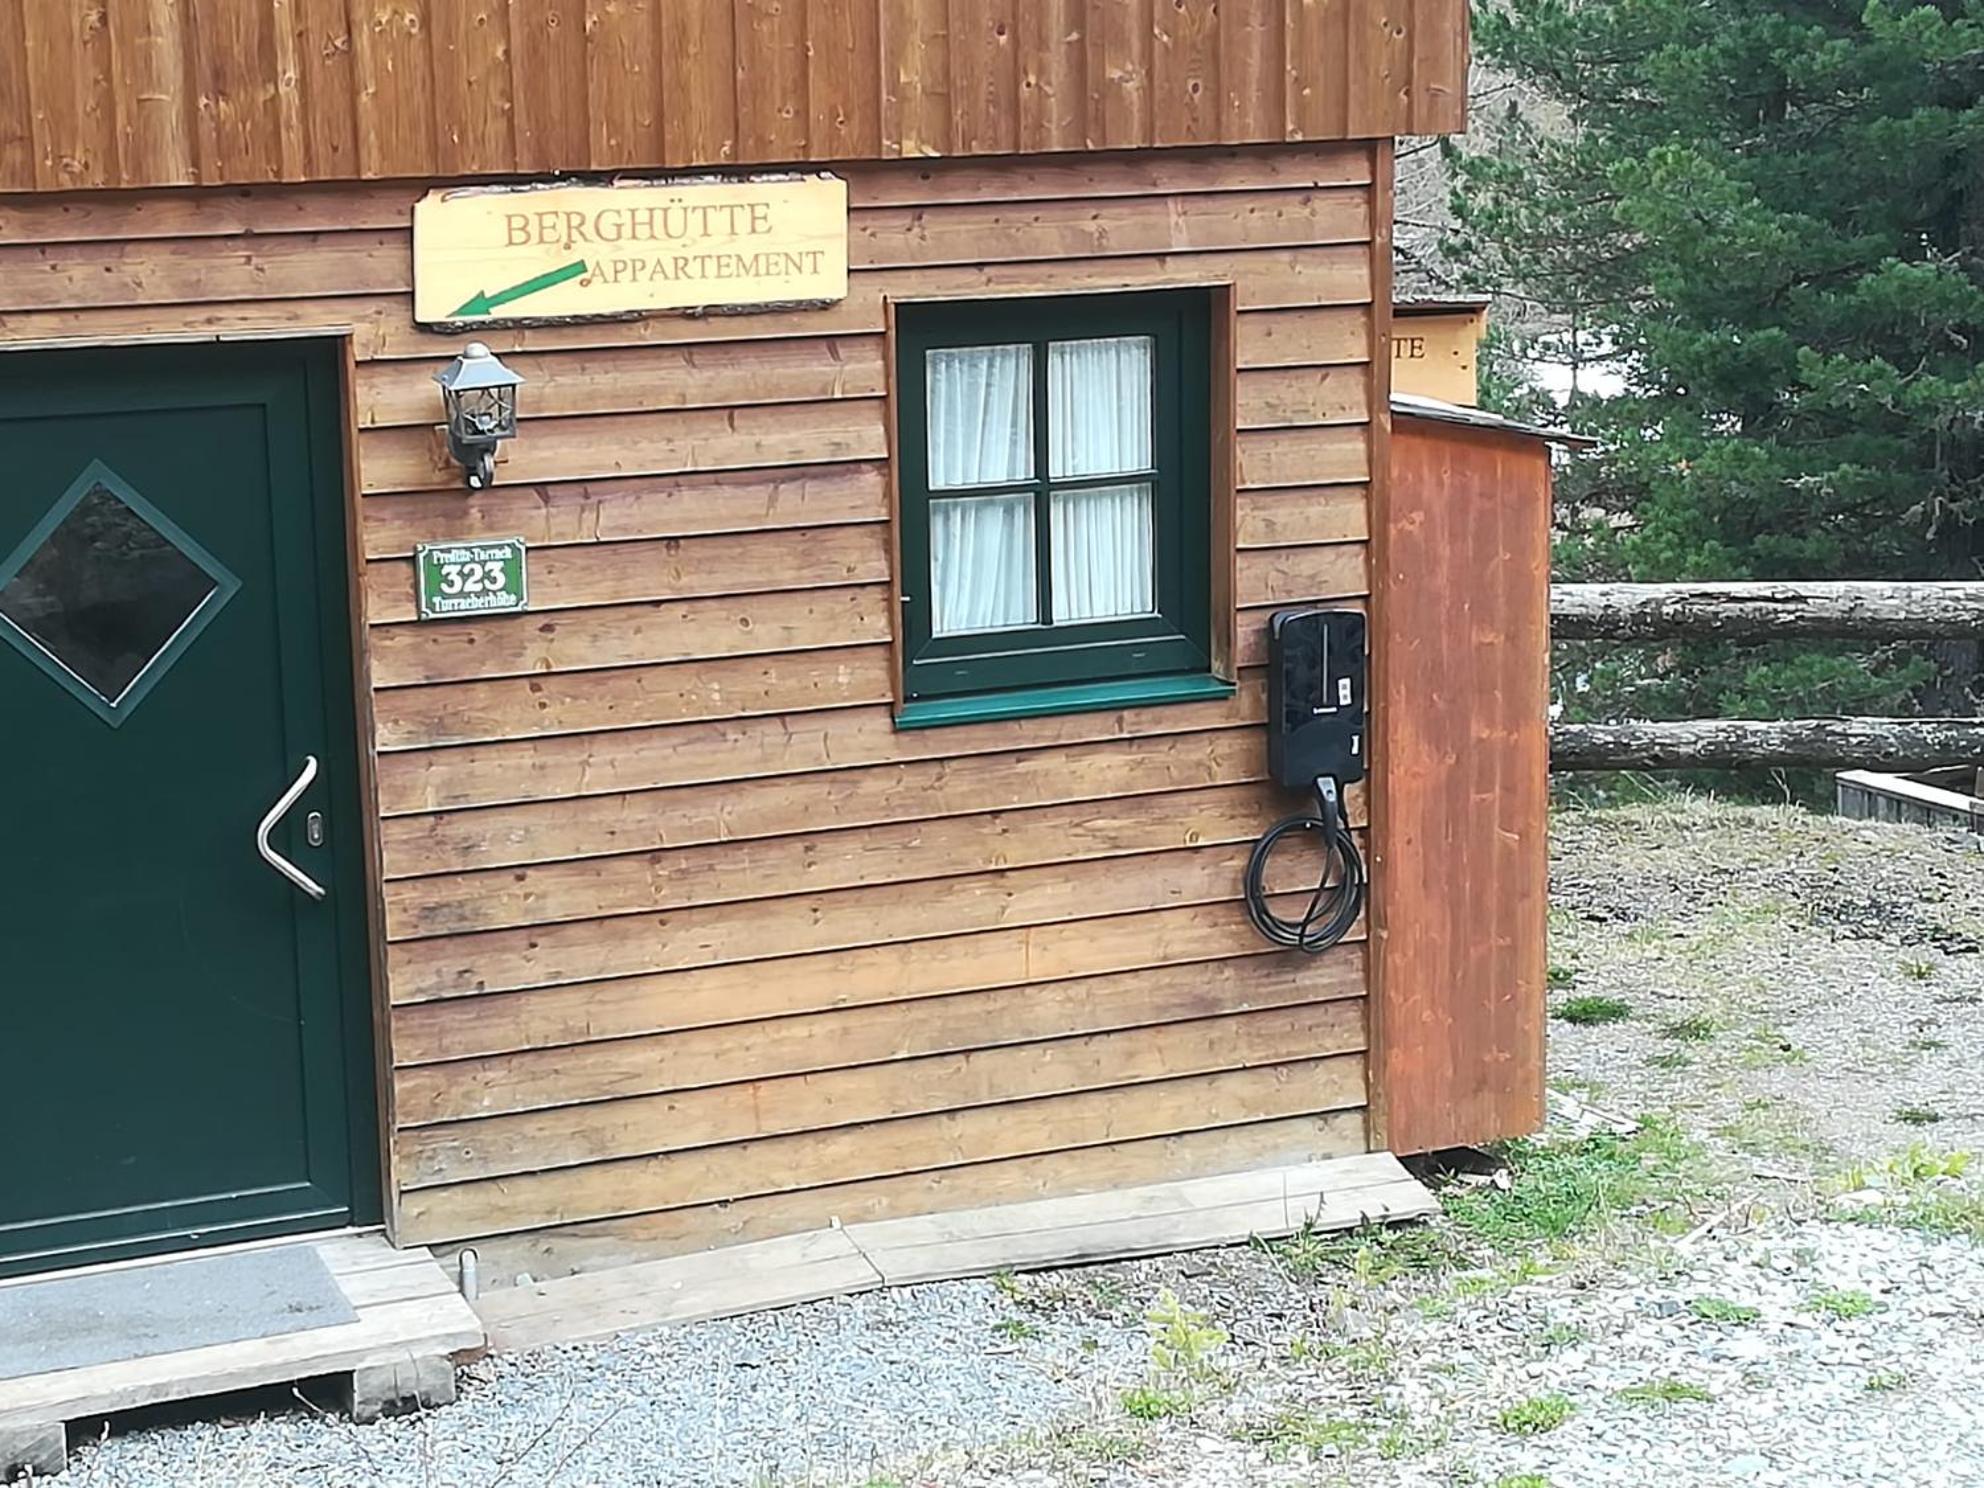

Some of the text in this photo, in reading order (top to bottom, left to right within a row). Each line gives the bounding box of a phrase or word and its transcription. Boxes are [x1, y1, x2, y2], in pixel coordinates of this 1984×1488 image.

[504, 198, 773, 247] BERGHÜTTE
[587, 250, 825, 284] APPARTEMENT
[440, 561, 505, 594] 323
